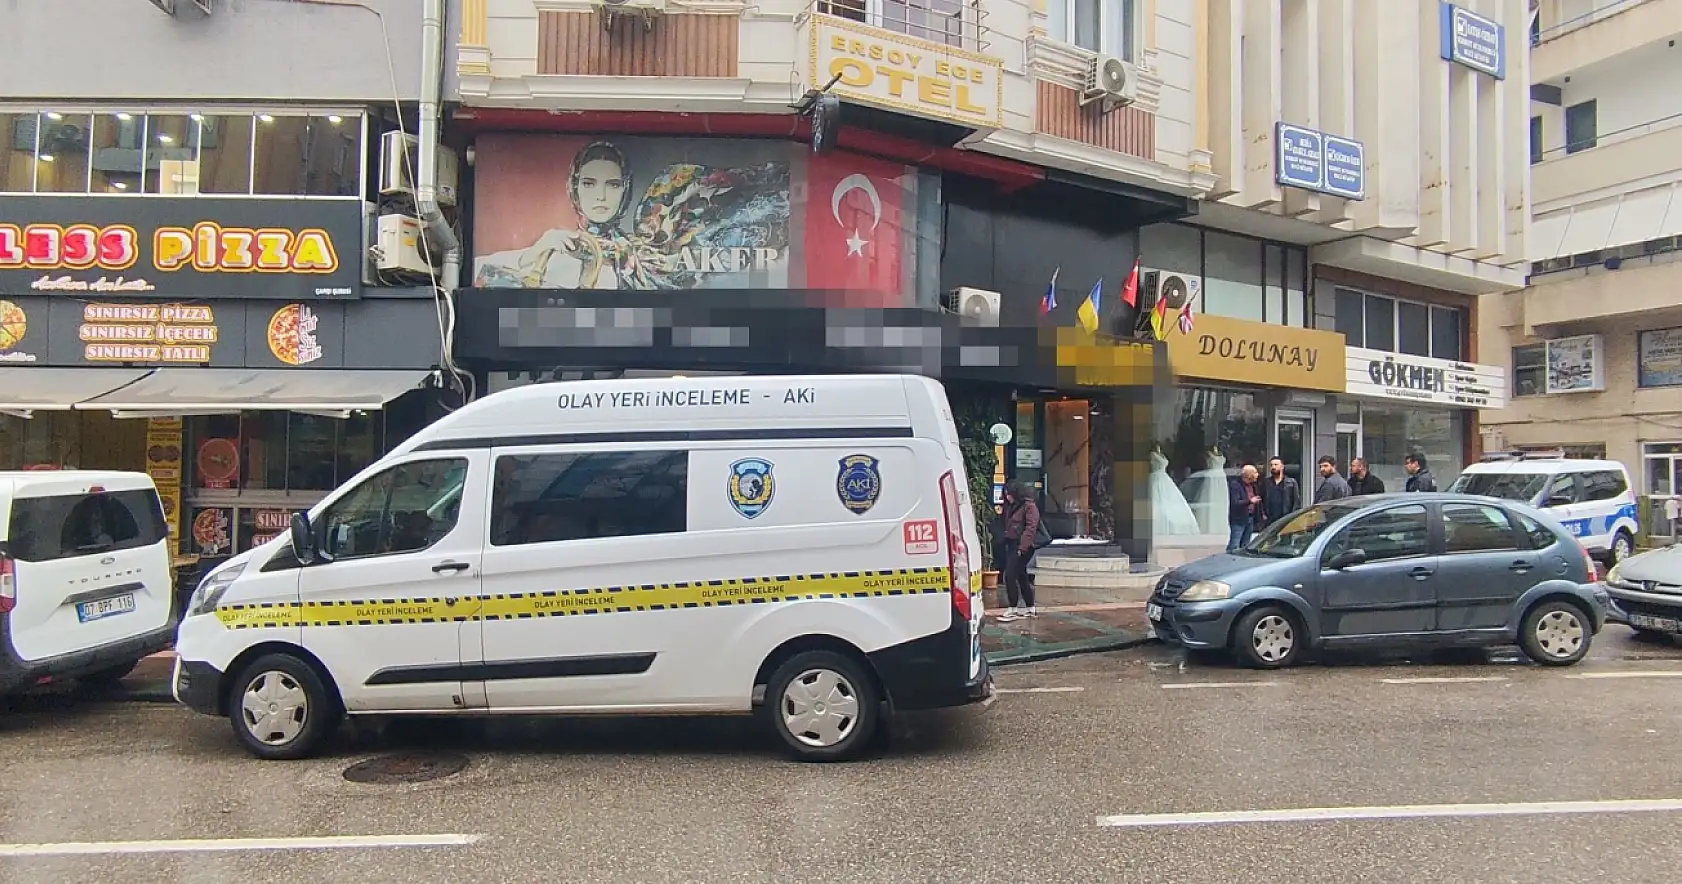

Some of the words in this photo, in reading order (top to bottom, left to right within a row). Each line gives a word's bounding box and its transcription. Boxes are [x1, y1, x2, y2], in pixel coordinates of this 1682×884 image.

[831, 34, 922, 69] ERSOY
[936, 59, 984, 84] EGE
[829, 57, 987, 115] OTEL
[157, 223, 335, 271] PİZZA
[675, 246, 781, 272] AKER
[86, 307, 158, 319] SINIRSIZ
[163, 305, 210, 320] PİZZA
[82, 327, 152, 339] SINIRSIZ
[87, 346, 158, 358] SINIRSIZ
[163, 347, 207, 359] TATLI
[1198, 334, 1317, 371] DOLUNAY
[1368, 356, 1445, 392] GÖKMEN
[557, 392, 605, 409] OLAY
[908, 523, 934, 541] 112
[702, 588, 722, 598] OLAY
[534, 600, 554, 609] OLAY
